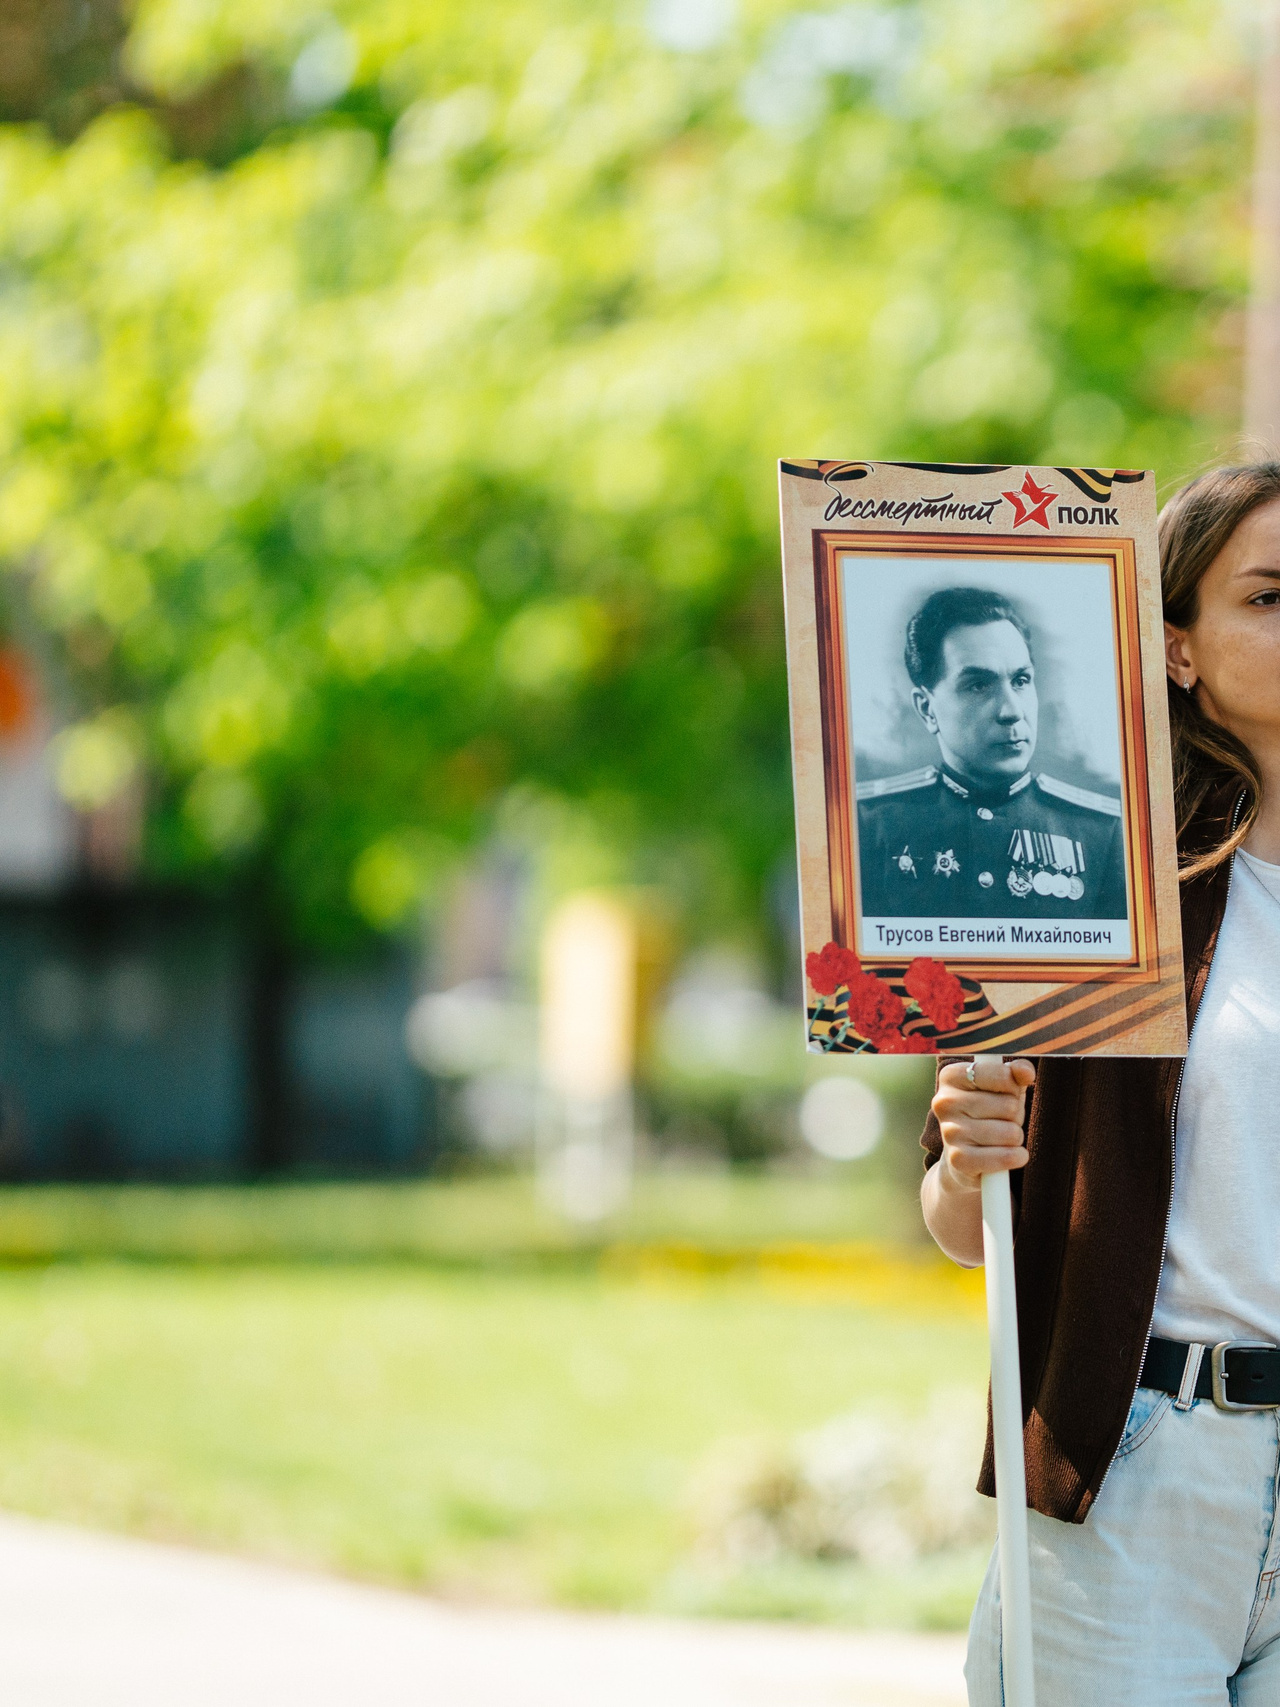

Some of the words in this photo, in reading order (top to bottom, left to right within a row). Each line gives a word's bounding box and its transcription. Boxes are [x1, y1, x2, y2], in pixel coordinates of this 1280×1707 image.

[1057, 506, 1119, 526] ПОЛК
[875, 924, 934, 946] Трусов
[939, 925, 1006, 944] Евгений
[1011, 926, 1112, 944] Михайлович
